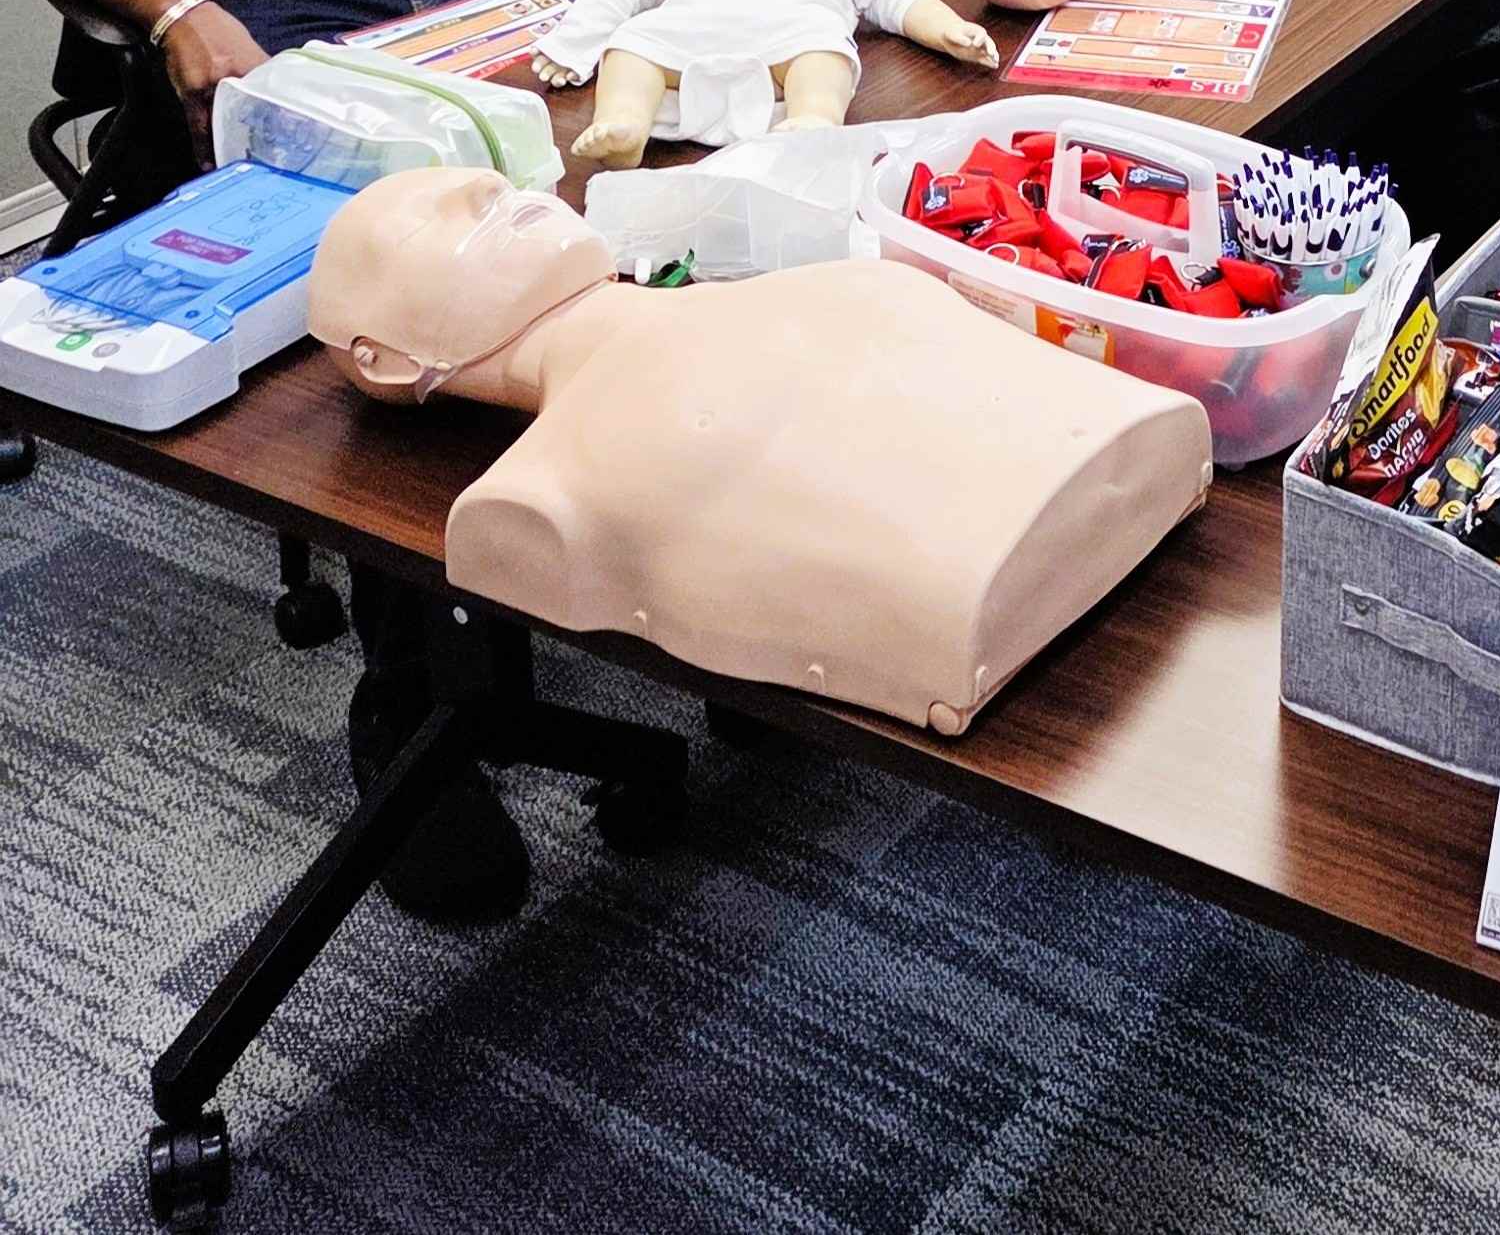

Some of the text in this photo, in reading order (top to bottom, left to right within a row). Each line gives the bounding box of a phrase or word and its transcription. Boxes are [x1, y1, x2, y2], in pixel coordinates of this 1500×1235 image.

[1189, 80, 1241, 95] BLS
[1350, 314, 1431, 439] Smartfood
[1368, 408, 1417, 460] Doritos
